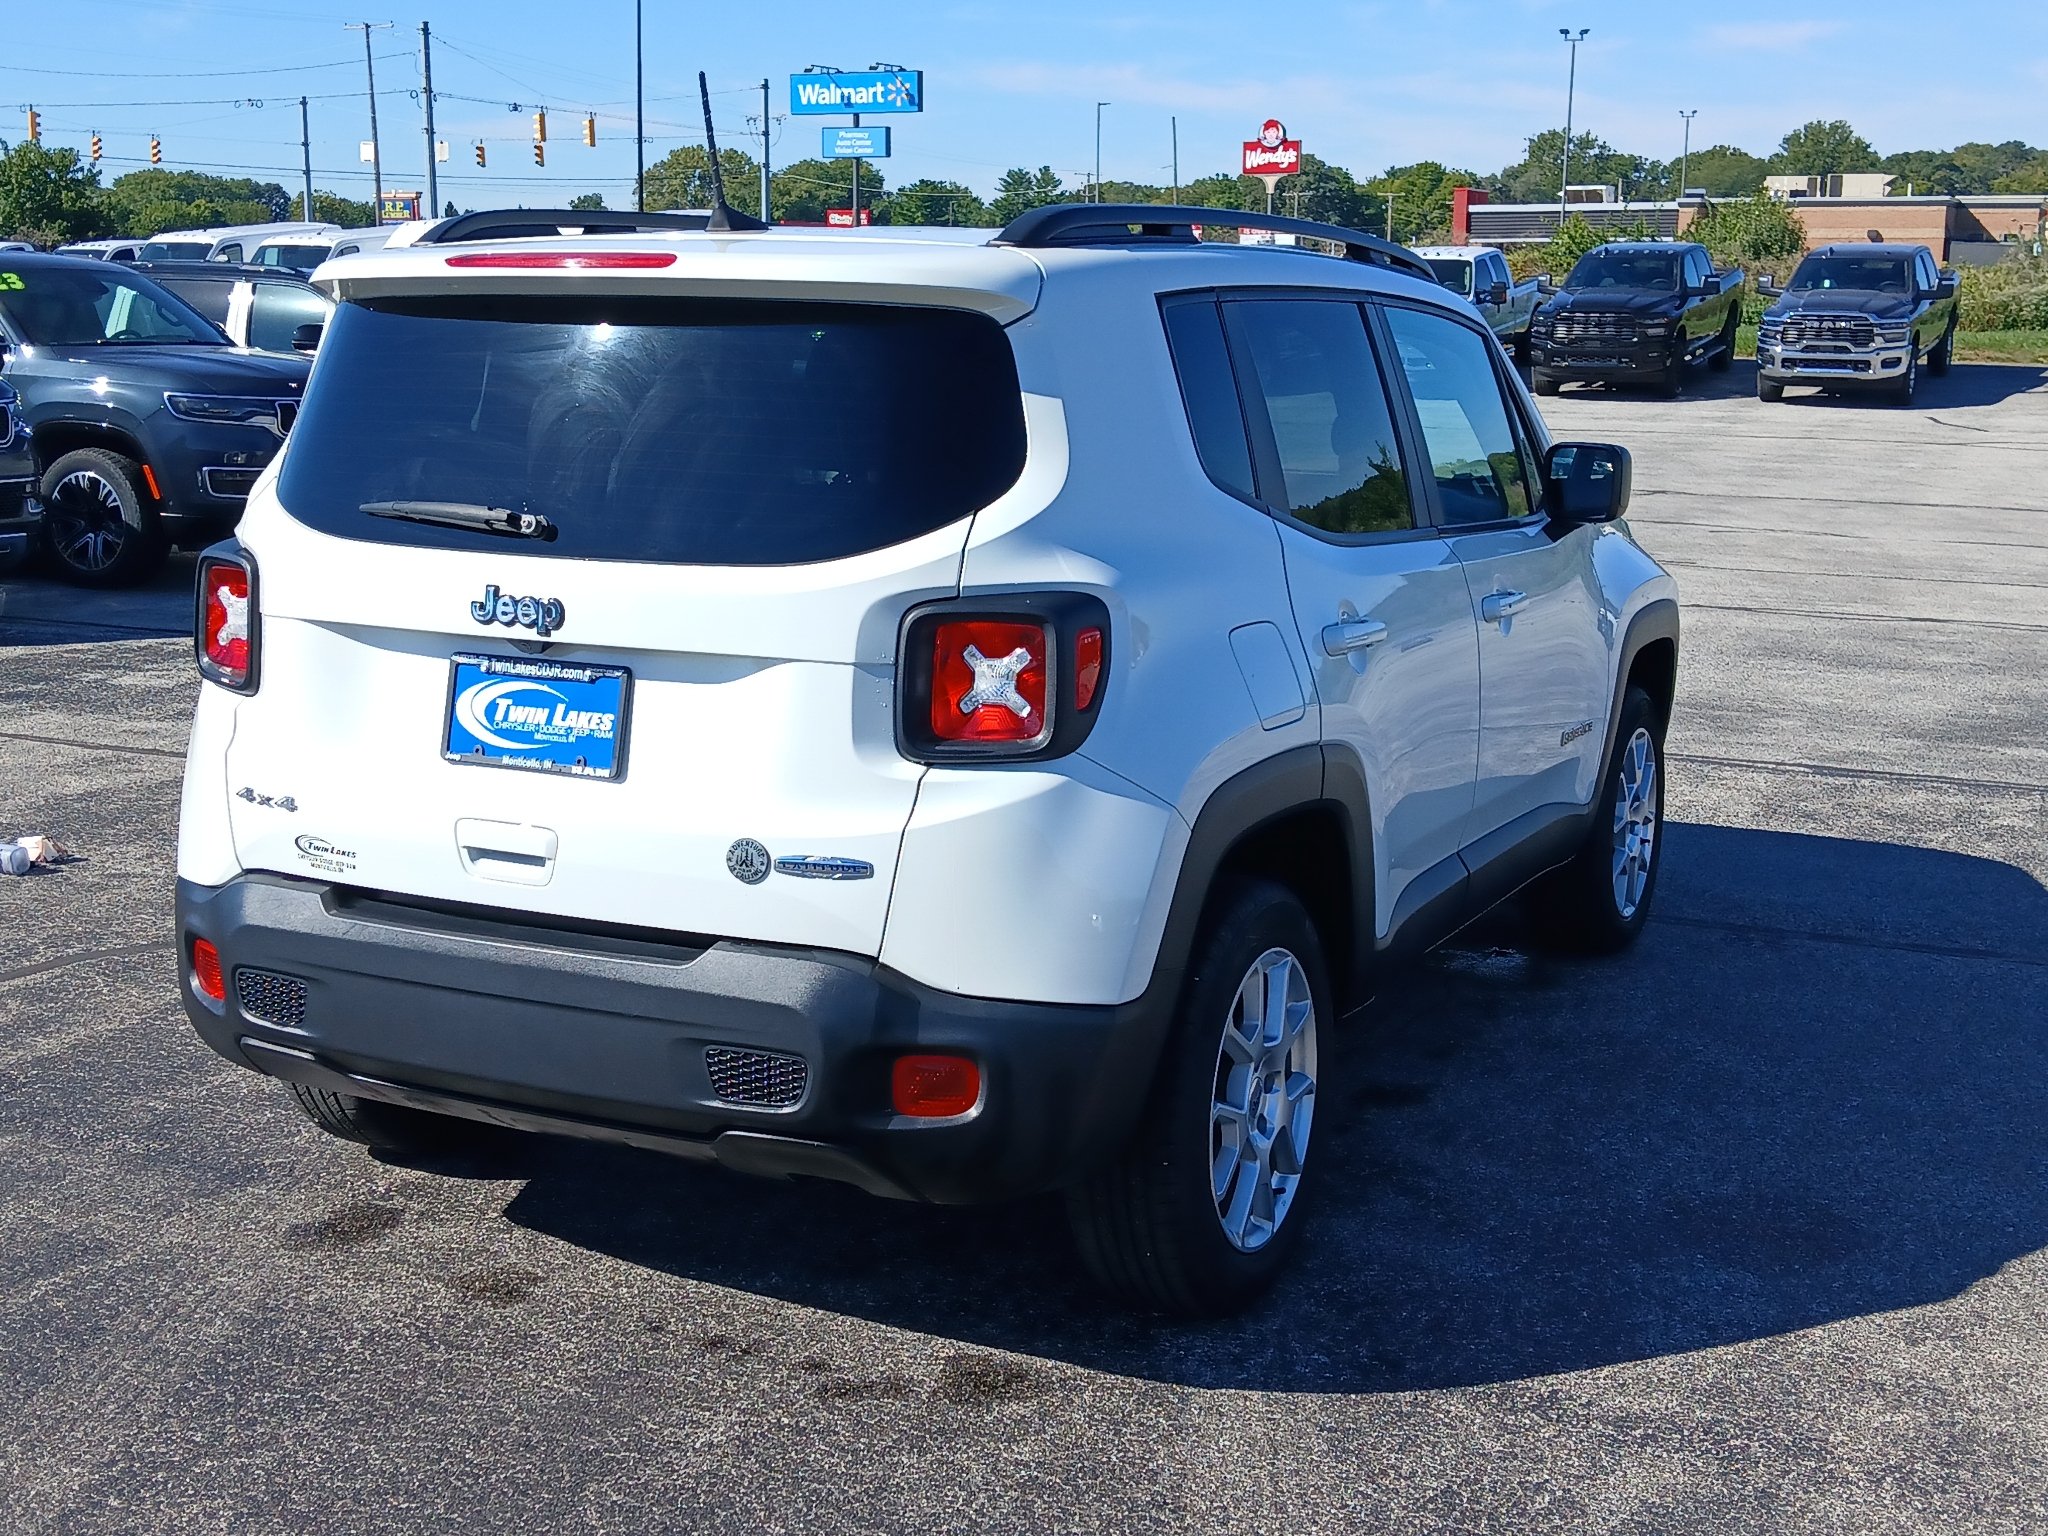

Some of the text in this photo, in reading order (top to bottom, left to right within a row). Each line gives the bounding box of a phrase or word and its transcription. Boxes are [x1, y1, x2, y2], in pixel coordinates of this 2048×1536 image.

[797, 82, 885, 105] Walmart
[838, 131, 869, 139] Pharmacy
[1245, 145, 1298, 169] Wendy's
[471, 584, 566, 637] Jeep
[491, 660, 583, 680] TwinLakesCDJR.com
[493, 721, 613, 739] CHRYSLER DODGE JEEP RAM
[541, 759, 552, 769] IN
[236, 787, 298, 812] 4x4
[729, 840, 766, 858] ADVENTURE
[736, 868, 763, 880] CALLING
